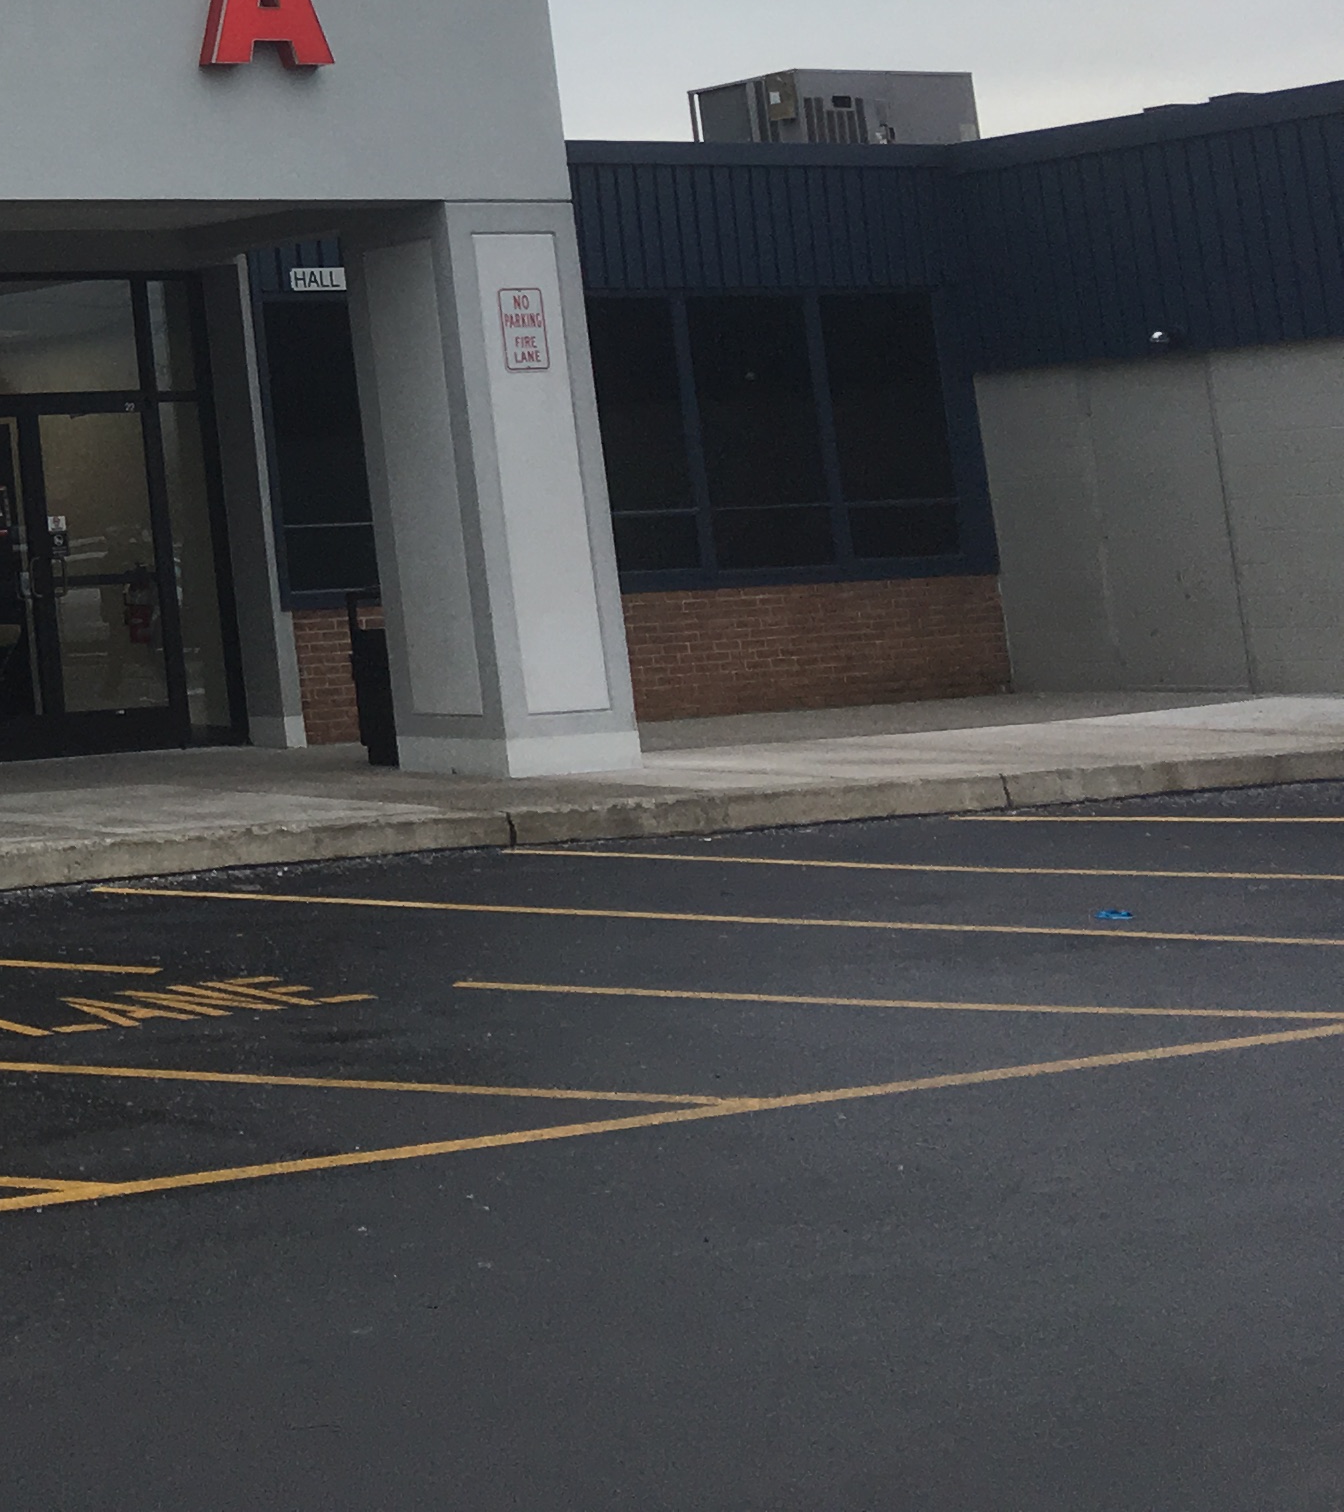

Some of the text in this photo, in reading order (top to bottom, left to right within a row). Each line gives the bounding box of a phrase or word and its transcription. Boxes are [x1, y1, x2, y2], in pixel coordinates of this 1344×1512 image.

[293, 270, 341, 288] HALL
[512, 294, 530, 310] NO
[504, 312, 542, 328] PARKING
[514, 335, 537, 349] FIRE
[514, 350, 542, 364] LANE
